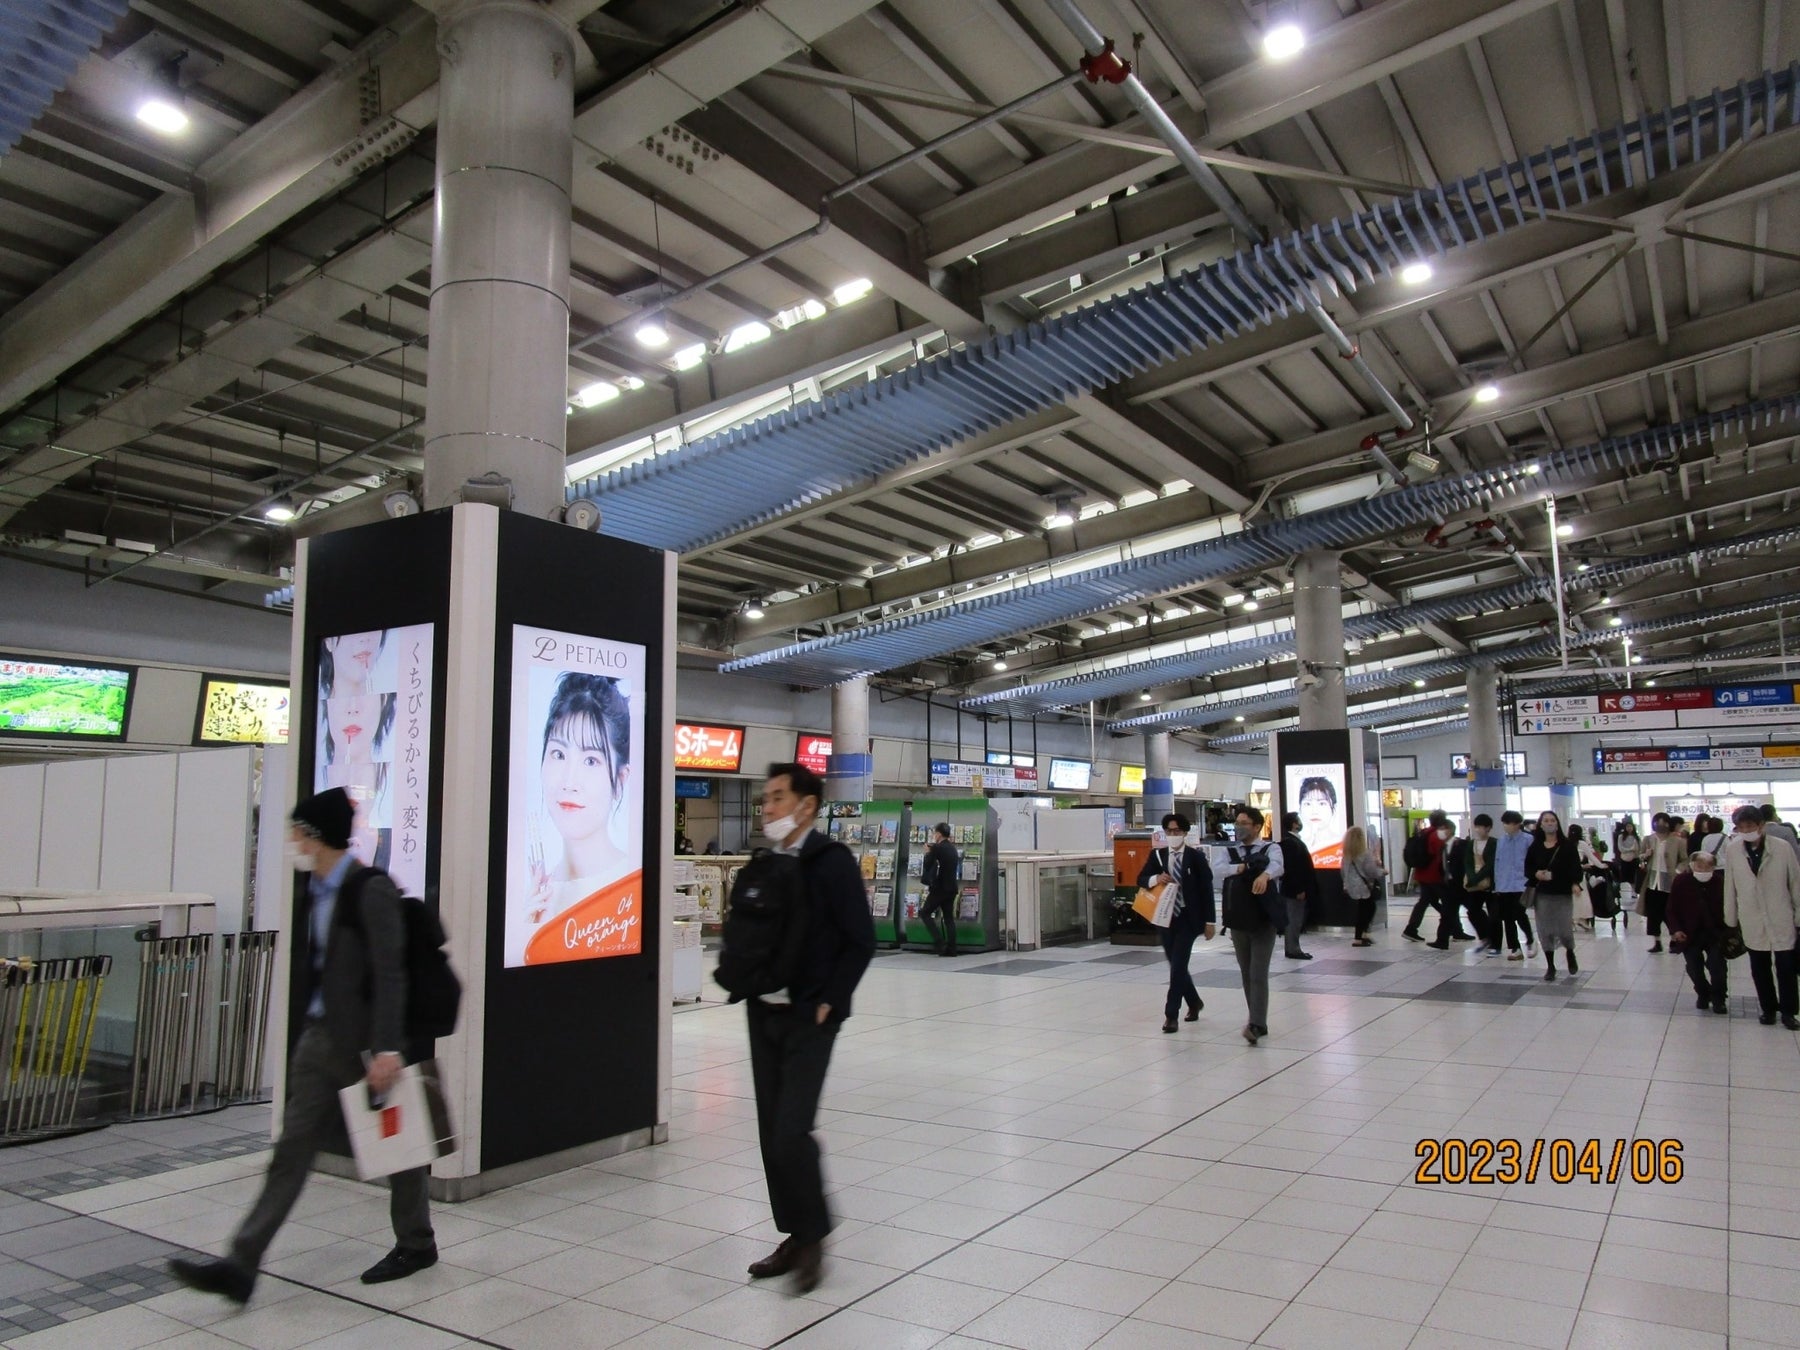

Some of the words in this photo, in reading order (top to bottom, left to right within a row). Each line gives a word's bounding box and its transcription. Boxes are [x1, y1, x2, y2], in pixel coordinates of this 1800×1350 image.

[565, 643, 628, 669] PETALO
[1543, 717, 1551, 727] 4
[402, 641, 424, 863] くちびるから、変わ
[675, 726, 740, 757] Sホーム
[702, 782, 708, 797] 5
[678, 812, 685, 826] 3
[617, 893, 633, 915] 04
[564, 917, 615, 949] Queen
[587, 915, 639, 948] orange
